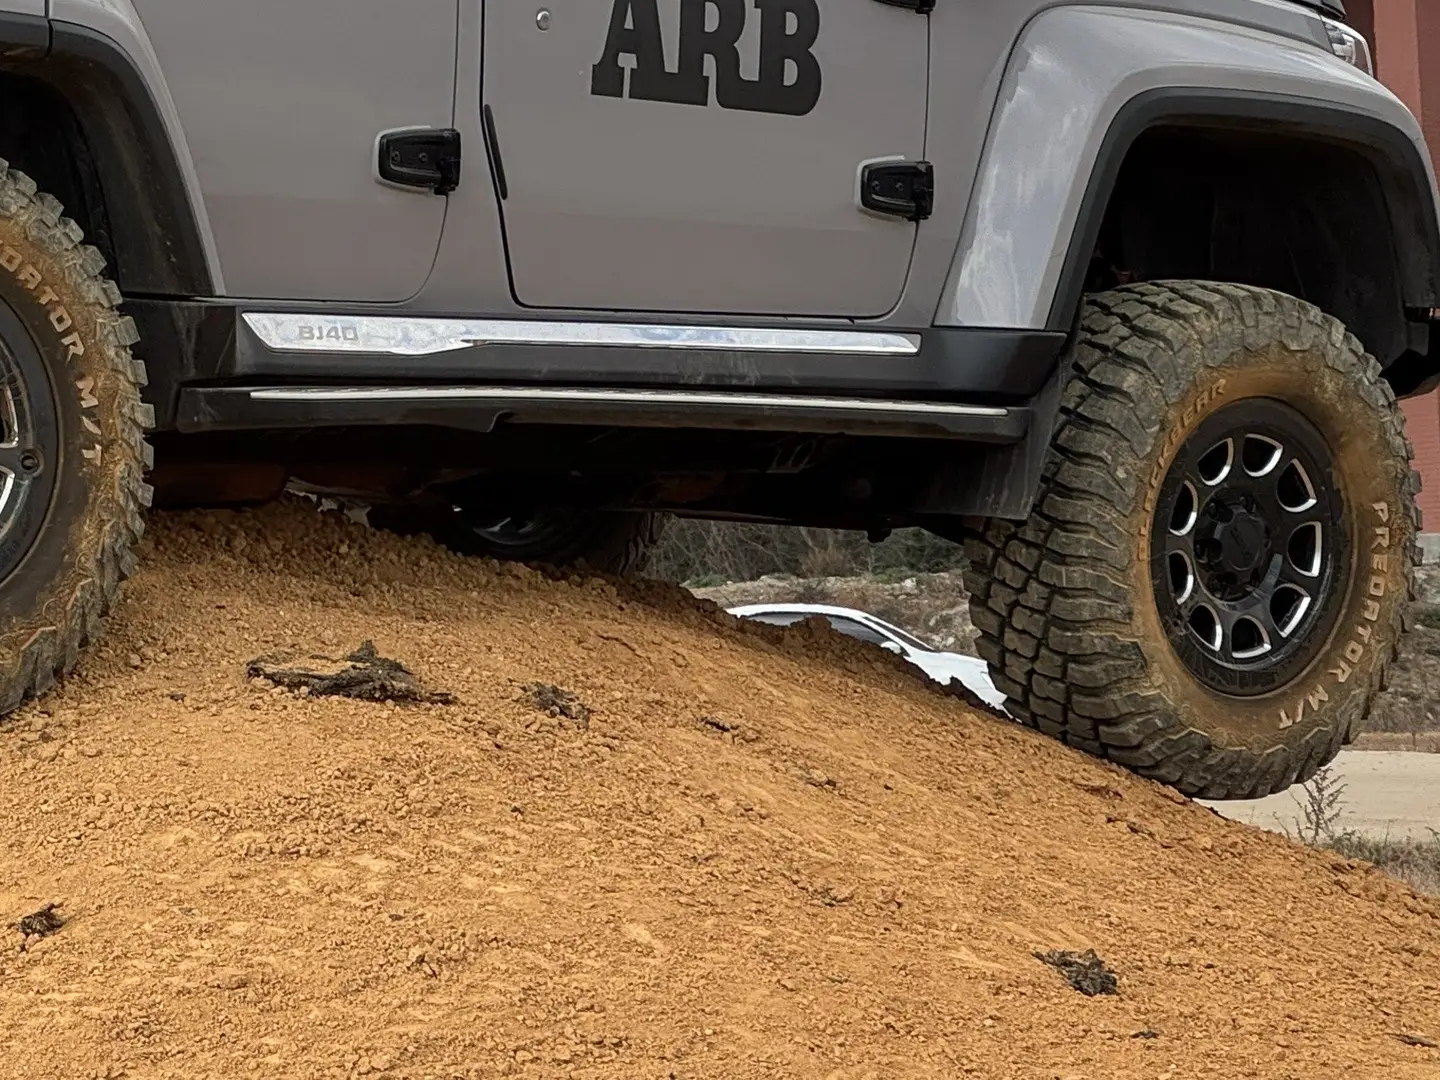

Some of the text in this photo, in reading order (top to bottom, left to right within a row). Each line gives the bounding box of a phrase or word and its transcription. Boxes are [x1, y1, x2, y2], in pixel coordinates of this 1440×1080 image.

[298, 325, 359, 341] BJ40
[75, 376, 103, 466] M/T
[1277, 500, 1391, 730] PREDATOR M/T
